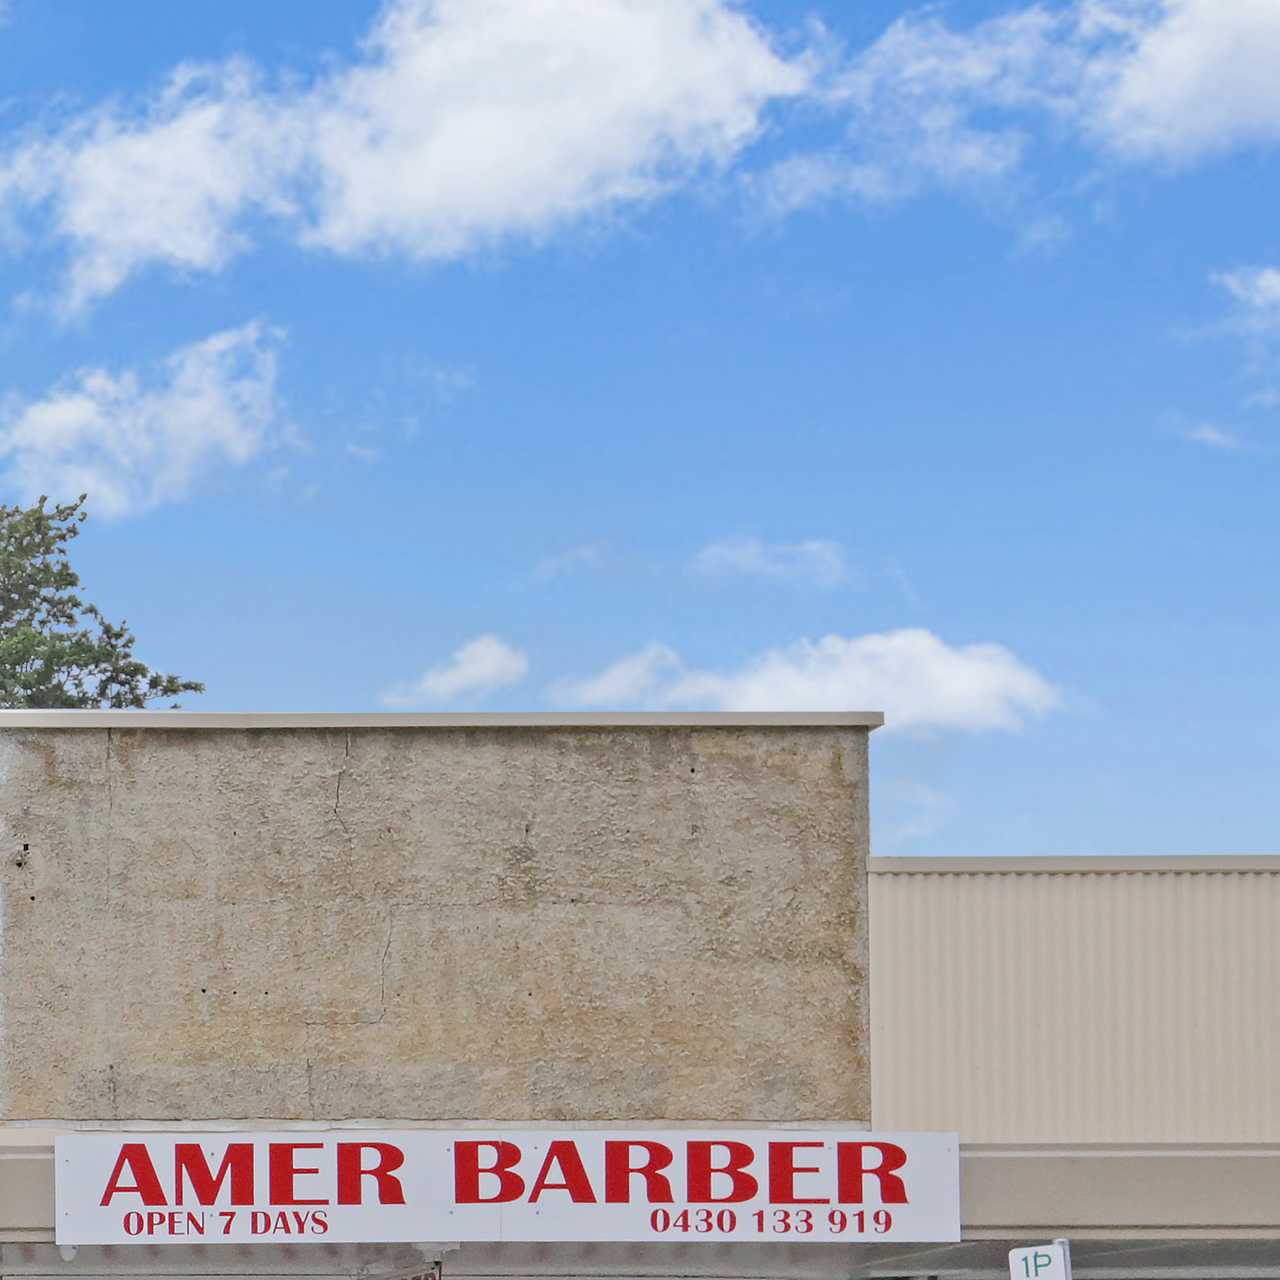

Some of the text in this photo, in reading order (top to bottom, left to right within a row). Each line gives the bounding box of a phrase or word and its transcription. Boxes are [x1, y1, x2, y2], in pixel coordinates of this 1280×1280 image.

[99, 1140, 909, 1206] AMER BARBER
[123, 1210, 329, 1236] OPEN 7 DAYS
[650, 1208, 893, 1234] 0430 133 919
[1021, 1251, 1052, 1278] 1P
